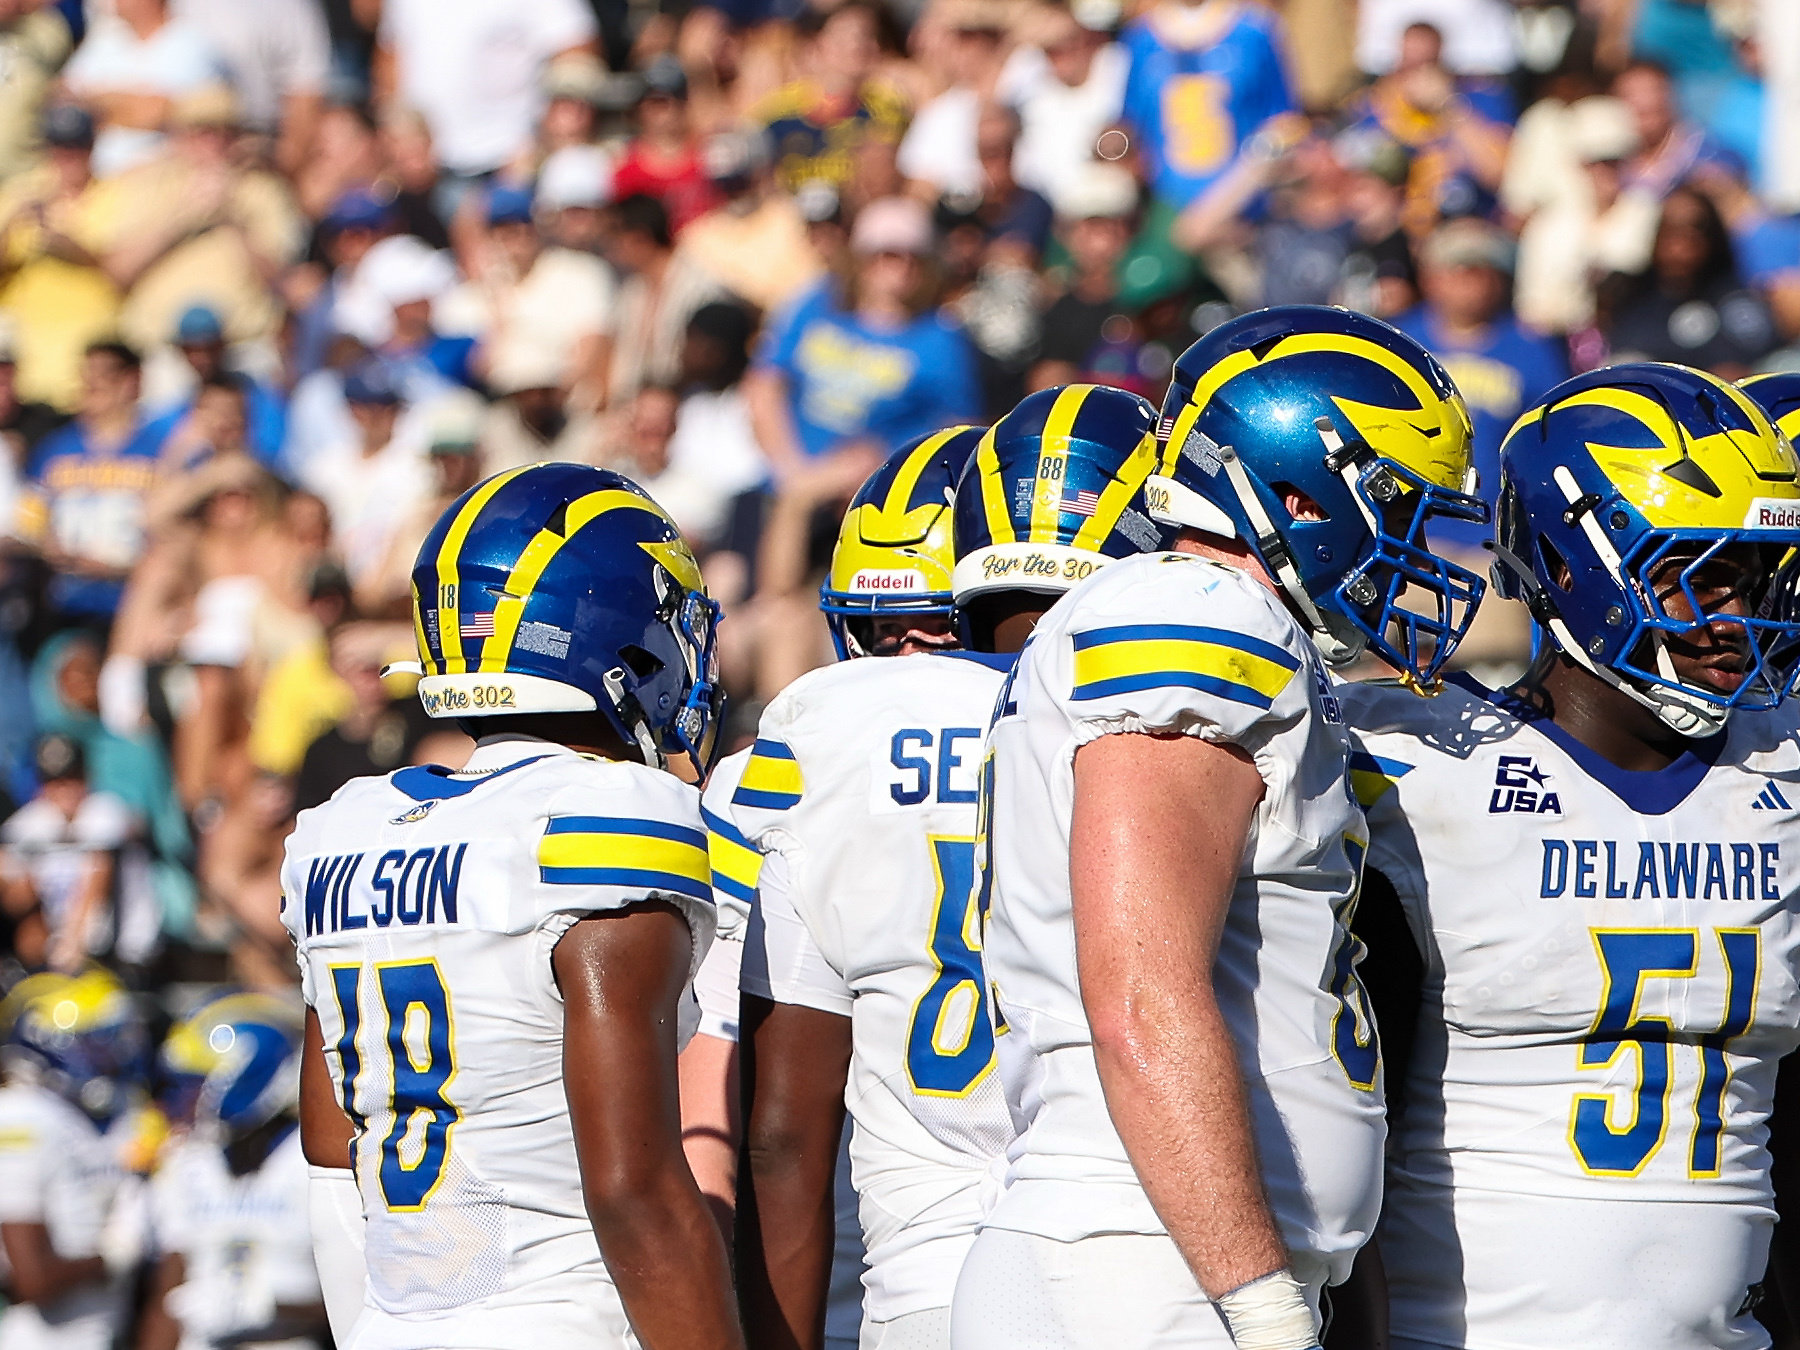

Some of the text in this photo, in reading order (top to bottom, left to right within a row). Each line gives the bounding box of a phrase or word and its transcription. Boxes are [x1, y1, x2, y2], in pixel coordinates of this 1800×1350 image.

[1040, 456, 1063, 480] 88
[982, 553, 1104, 581] For the 30
[857, 575, 914, 589] Riddell
[440, 584, 456, 609] 18
[443, 686, 469, 708] the
[473, 686, 516, 708] 302
[1488, 789, 1562, 815] USA
[1540, 838, 1781, 901] DELAWARE
[305, 842, 469, 937] WILSON
[1566, 926, 1763, 1180] 51
[326, 956, 466, 1213] 18
